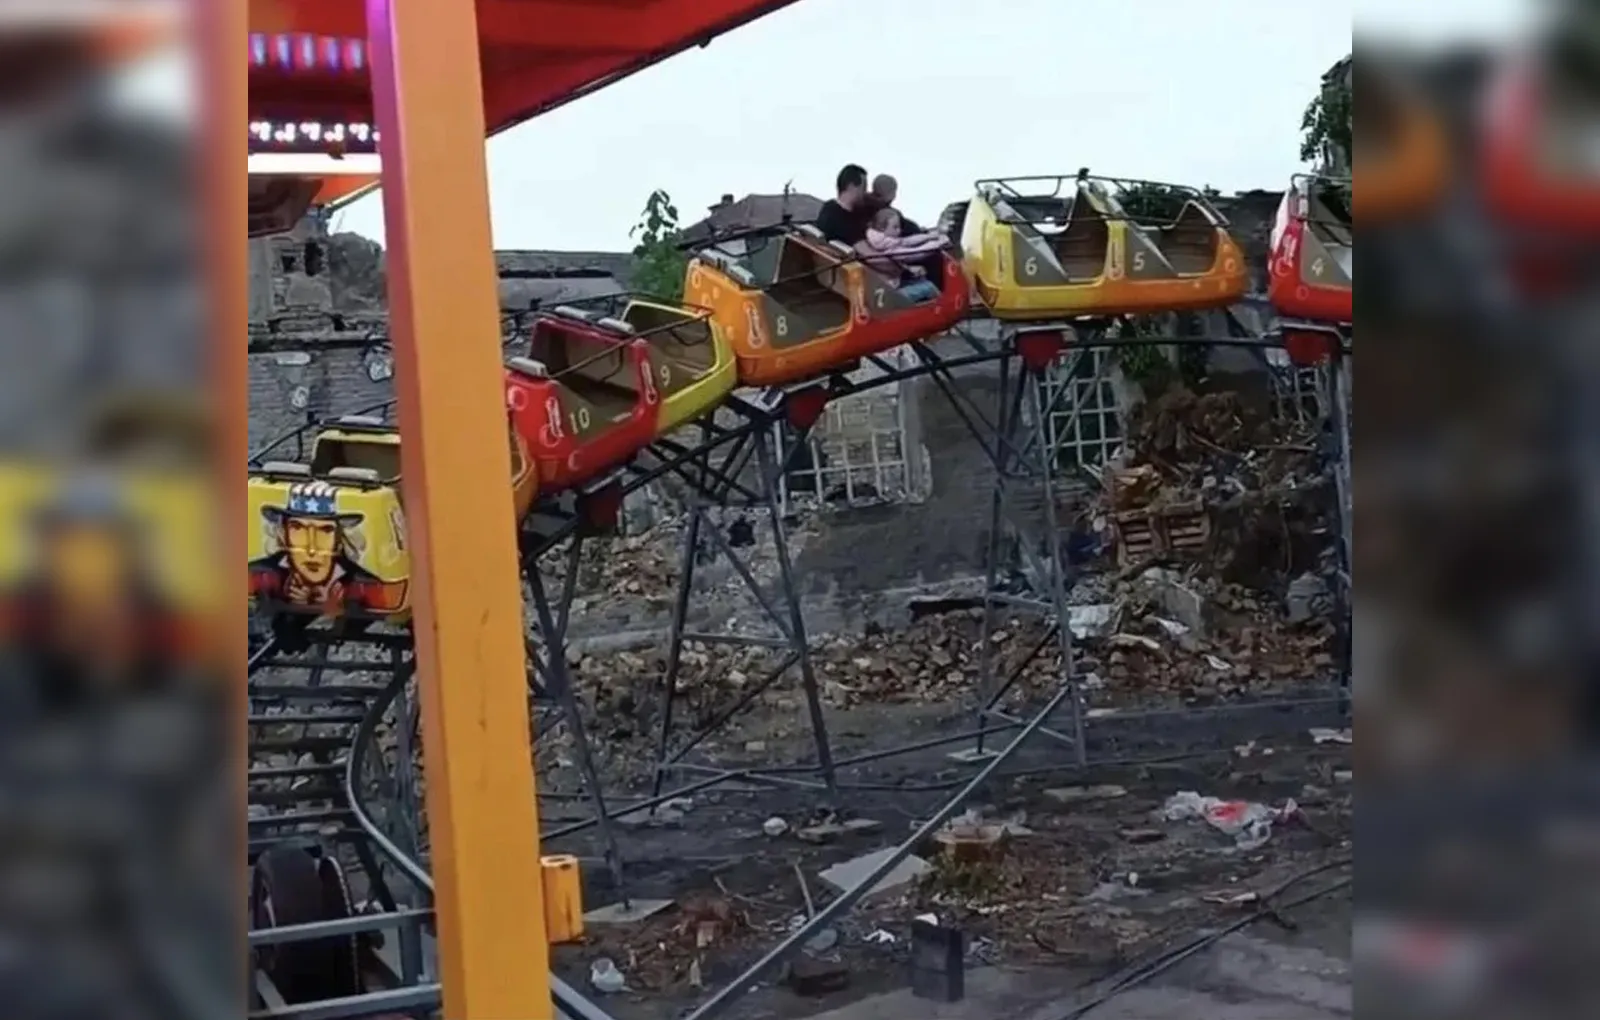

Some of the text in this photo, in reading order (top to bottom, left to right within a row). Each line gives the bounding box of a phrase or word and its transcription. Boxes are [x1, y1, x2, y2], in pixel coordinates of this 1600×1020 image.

[1025, 257, 1038, 275] 6
[1133, 251, 1145, 270] 5
[1311, 259, 1324, 277] 4
[874, 287, 885, 308] 7
[777, 315, 788, 336] 8
[661, 365, 671, 386] 9
[569, 408, 590, 434] 10
